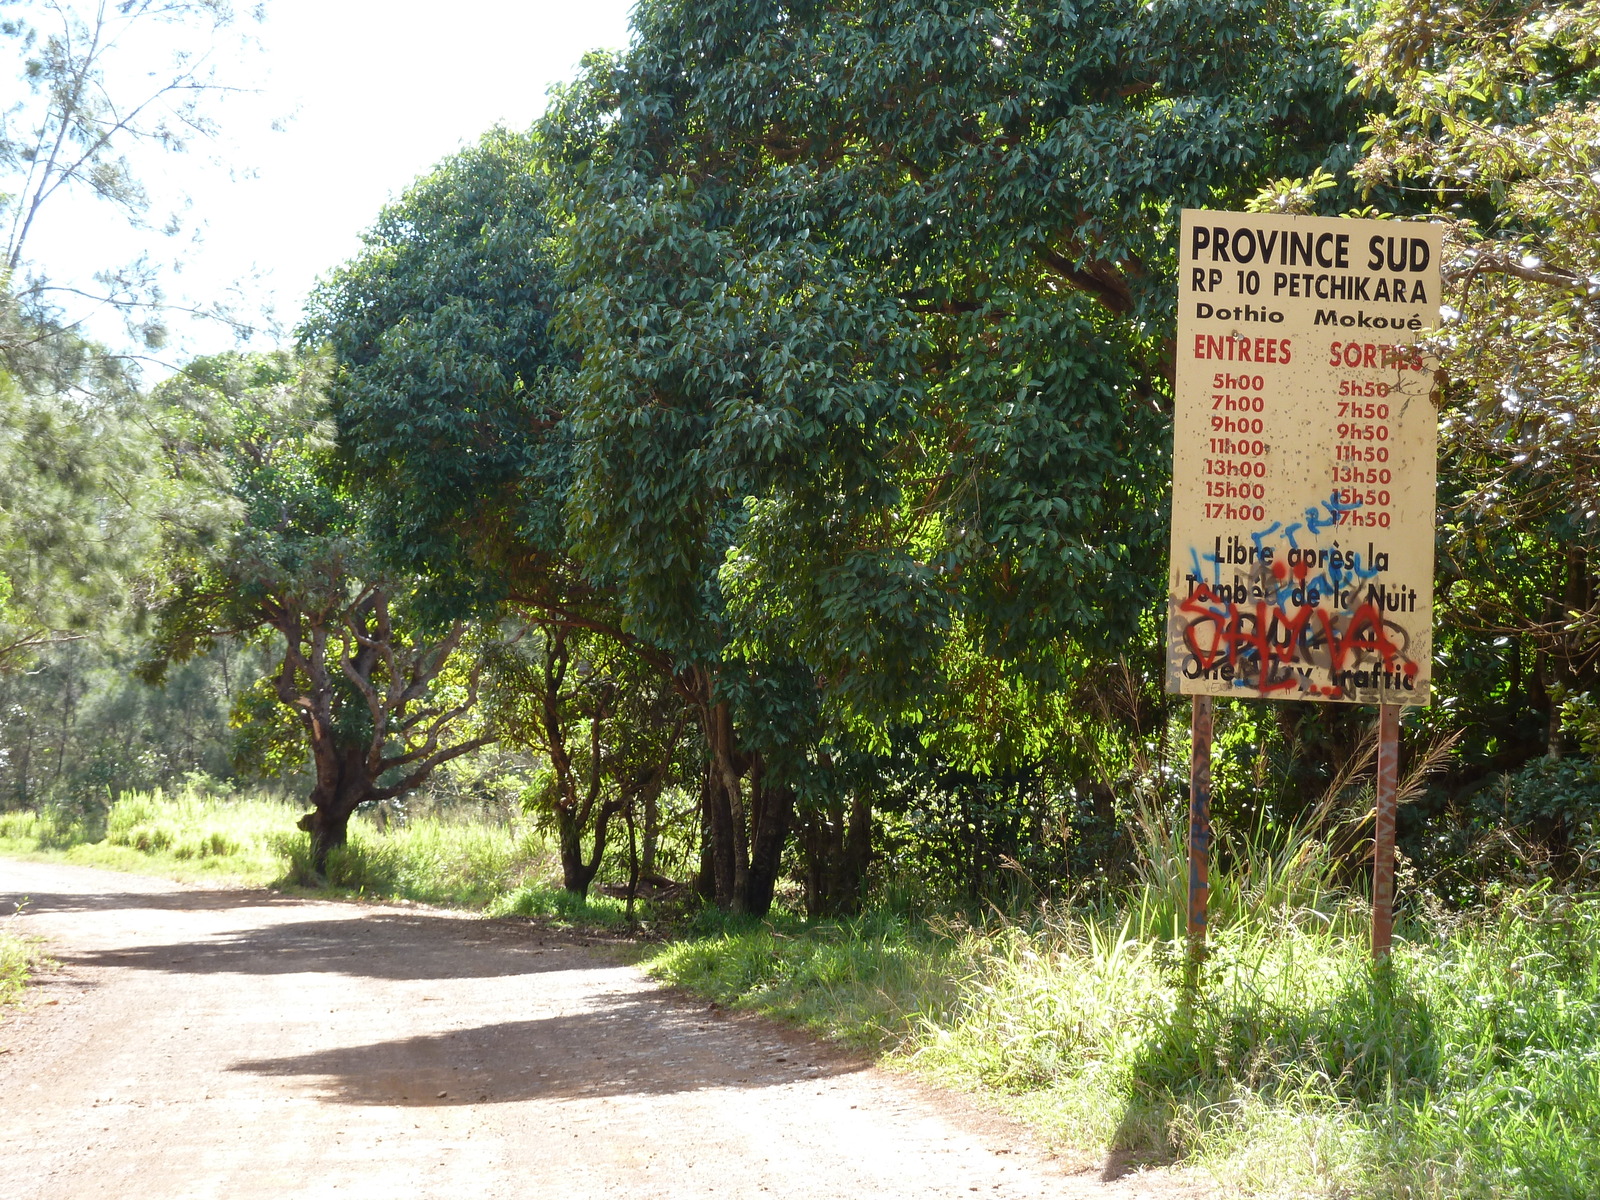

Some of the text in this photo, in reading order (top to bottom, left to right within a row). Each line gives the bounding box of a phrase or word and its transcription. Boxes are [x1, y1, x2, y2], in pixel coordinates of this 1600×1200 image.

[1191, 226, 1430, 272] PROVINCE SUD
[1192, 267, 1427, 304] RP 10 PETCHIKARA
[1196, 302, 1284, 323] Dothio
[1313, 309, 1422, 330] Mokoué
[1194, 334, 1291, 364] ENTREES
[1212, 373, 1264, 391] 5h00
[1338, 380, 1389, 398] 5h50
[1211, 395, 1264, 413] 7h00
[1337, 402, 1389, 420] 7h50
[1211, 416, 1264, 434] 9h00
[1337, 423, 1389, 441] 9h50
[1209, 438, 1264, 456] 11h00
[1336, 445, 1389, 463] 11h50
[1206, 459, 1266, 478] 13h00
[1332, 467, 1391, 485] 13h50
[1206, 481, 1265, 499] 15h00
[1332, 488, 1391, 506] 15h50
[1204, 503, 1265, 521] 17h00
[1332, 510, 1391, 528] 17h50
[1215, 536, 1389, 573] Libre après la
[1291, 577, 1320, 608] de
[1368, 584, 1417, 612] Nuit
[1182, 654, 1235, 681] One
